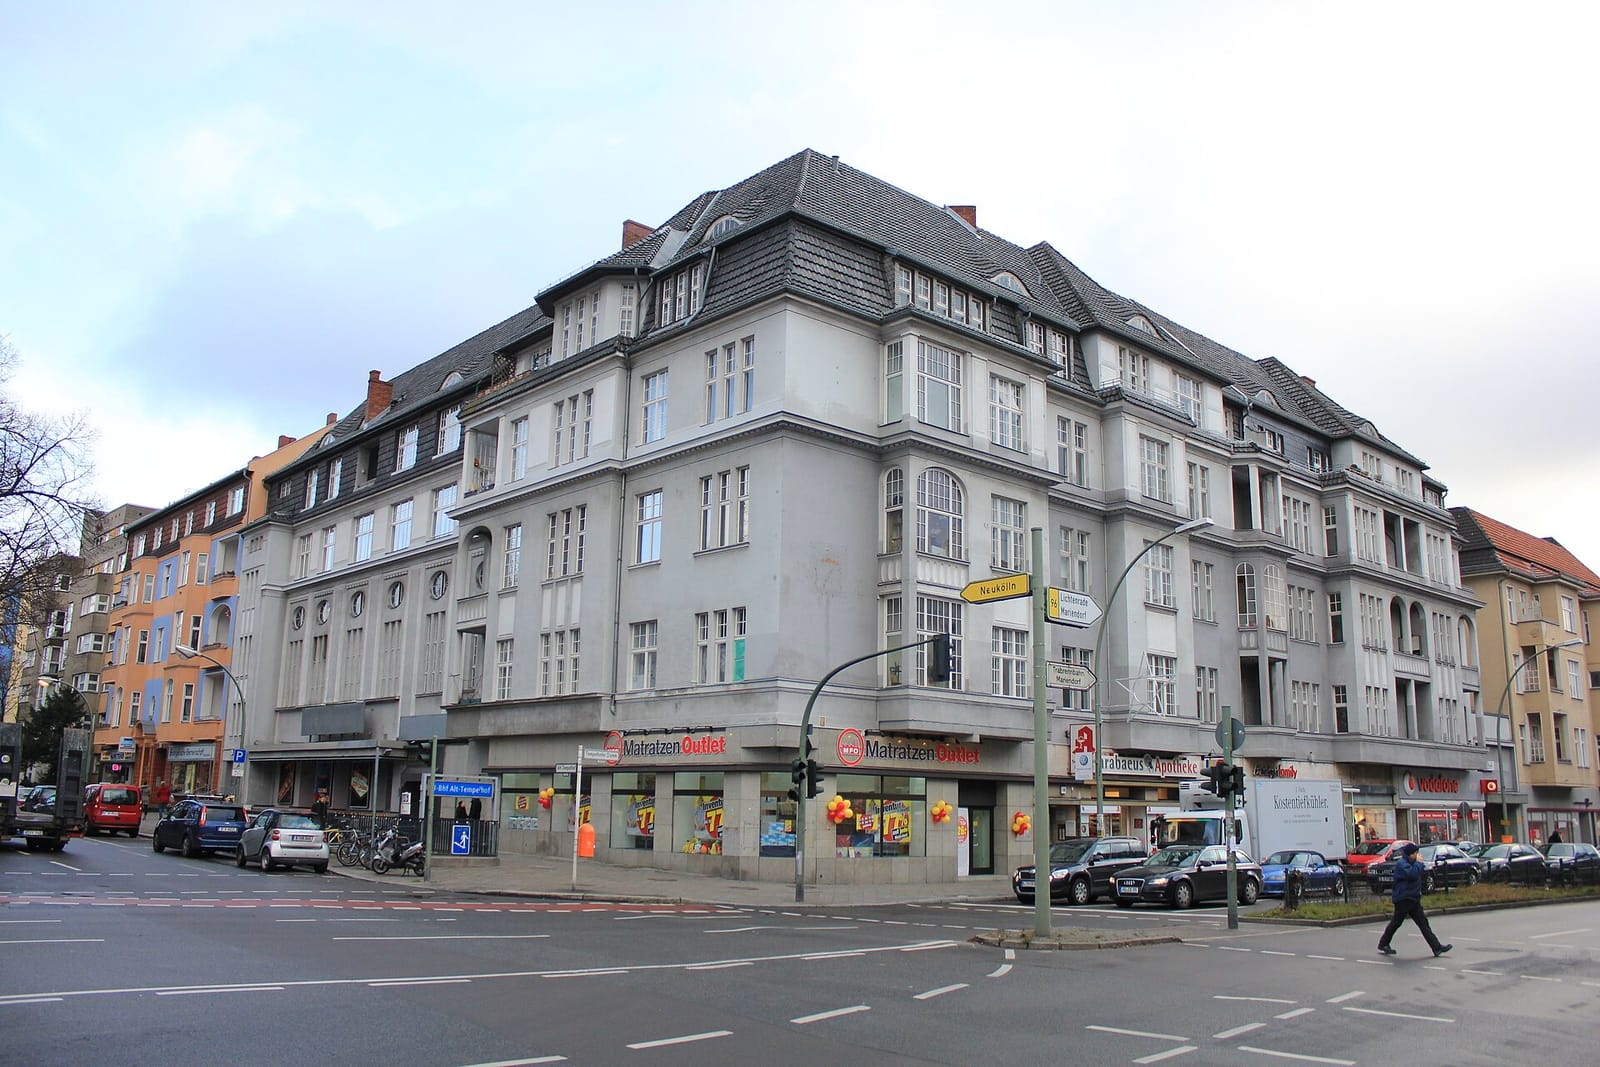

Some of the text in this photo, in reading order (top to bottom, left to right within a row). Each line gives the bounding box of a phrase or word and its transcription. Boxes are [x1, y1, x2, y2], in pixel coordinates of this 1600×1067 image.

[980, 581, 1016, 595] Neukölln
[1050, 598, 1058, 608] 96
[1060, 591, 1089, 607] Lichtenrade
[1060, 605, 1087, 620] Mariendorf
[623, 735, 726, 756] Matratzen Outlet
[865, 740, 980, 764] Matratzen Outlet
[1154, 756, 1198, 777] Apotheke
[1418, 774, 1459, 794] vodafone
